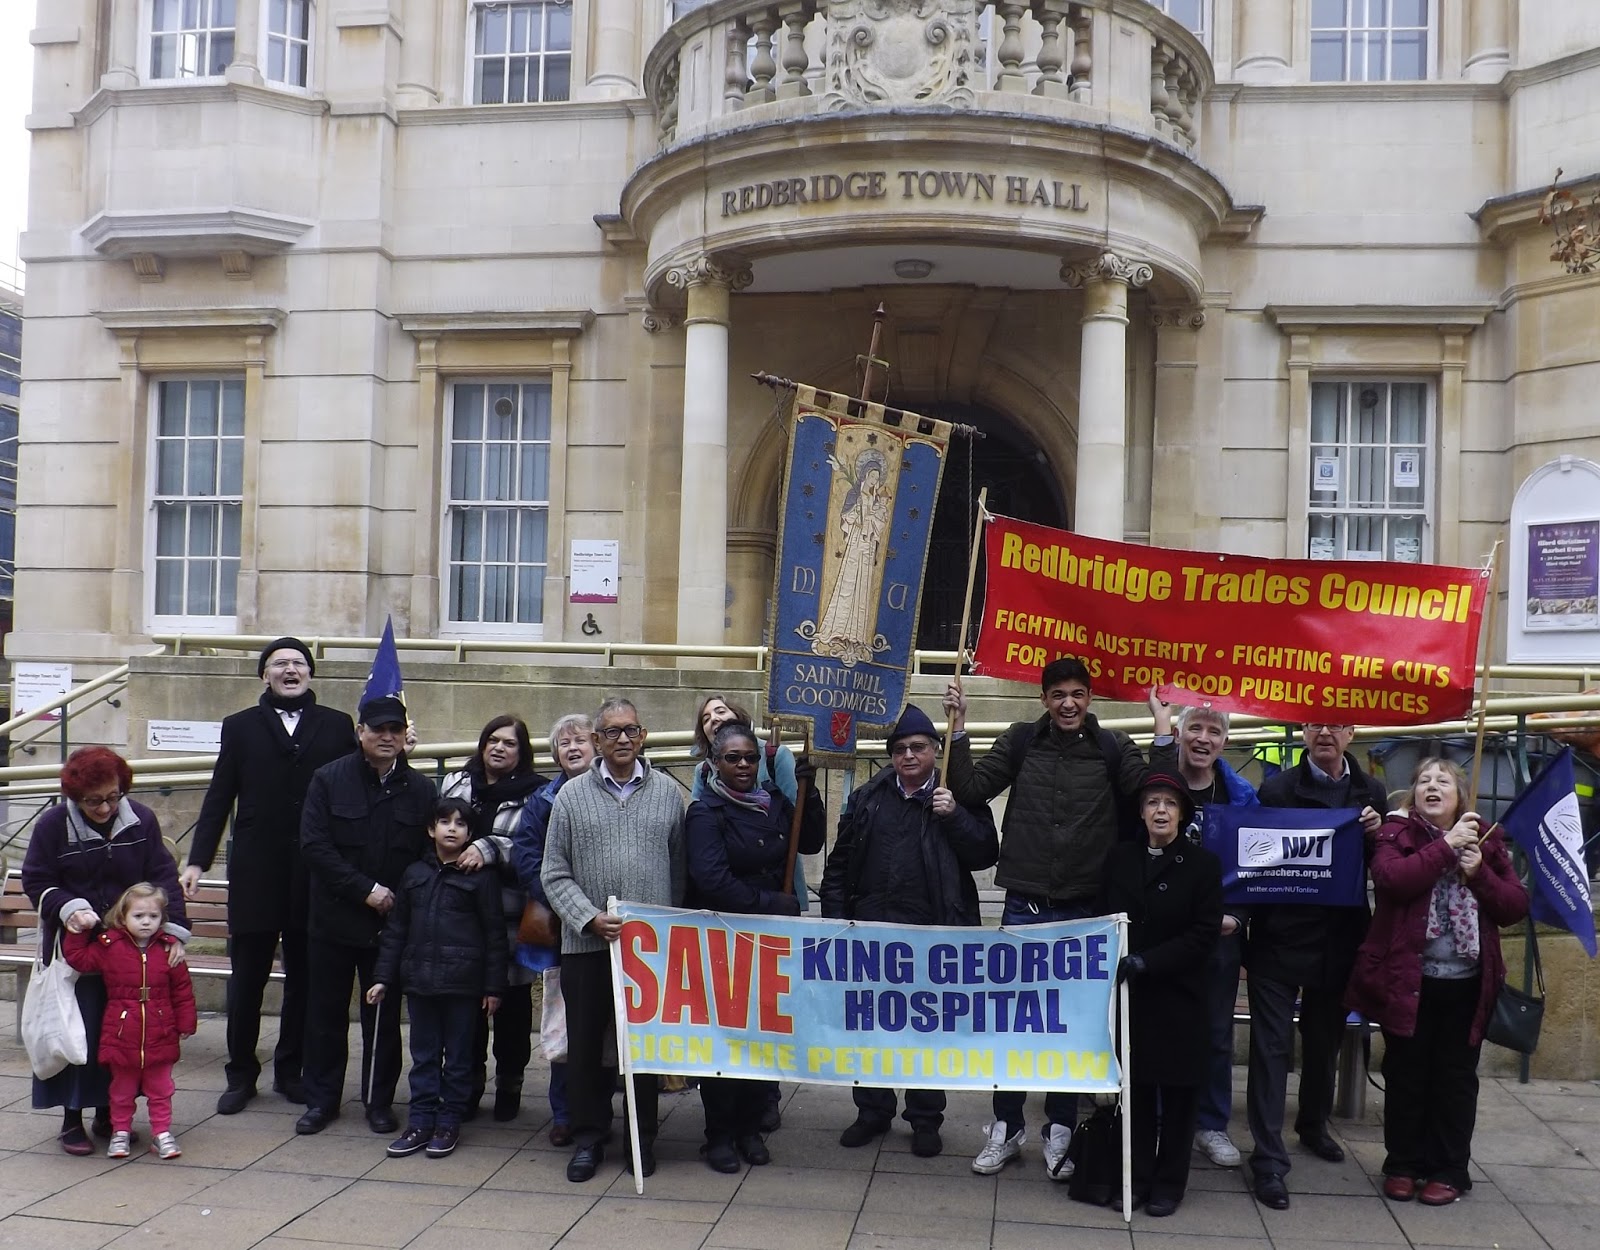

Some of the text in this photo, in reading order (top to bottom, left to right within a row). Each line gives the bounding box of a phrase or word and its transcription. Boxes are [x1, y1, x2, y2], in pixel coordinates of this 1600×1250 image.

[720, 170, 1090, 218] REDBRIDGE TOWN HALL
[1000, 531, 1473, 623] Redbridge Trades Council
[995, 608, 1451, 688] FIGHTING AUSTERITY FIGHTING THE CUTS
[785, 685, 888, 716] GOODMAYES
[794, 663, 885, 695] SAINT PAUL
[1005, 642, 1430, 716] FOR BS FOR GOOD PUBLIC SERVICES
[1281, 835, 1331, 860] NUT
[1246, 885, 1320, 894] twitter.com/NUTonline
[619, 918, 1111, 1035] SAVE KING GEORGE
[843, 987, 1069, 1035] HOSPITAL
[627, 1032, 1112, 1081] SIGN THE PETITION NOW
